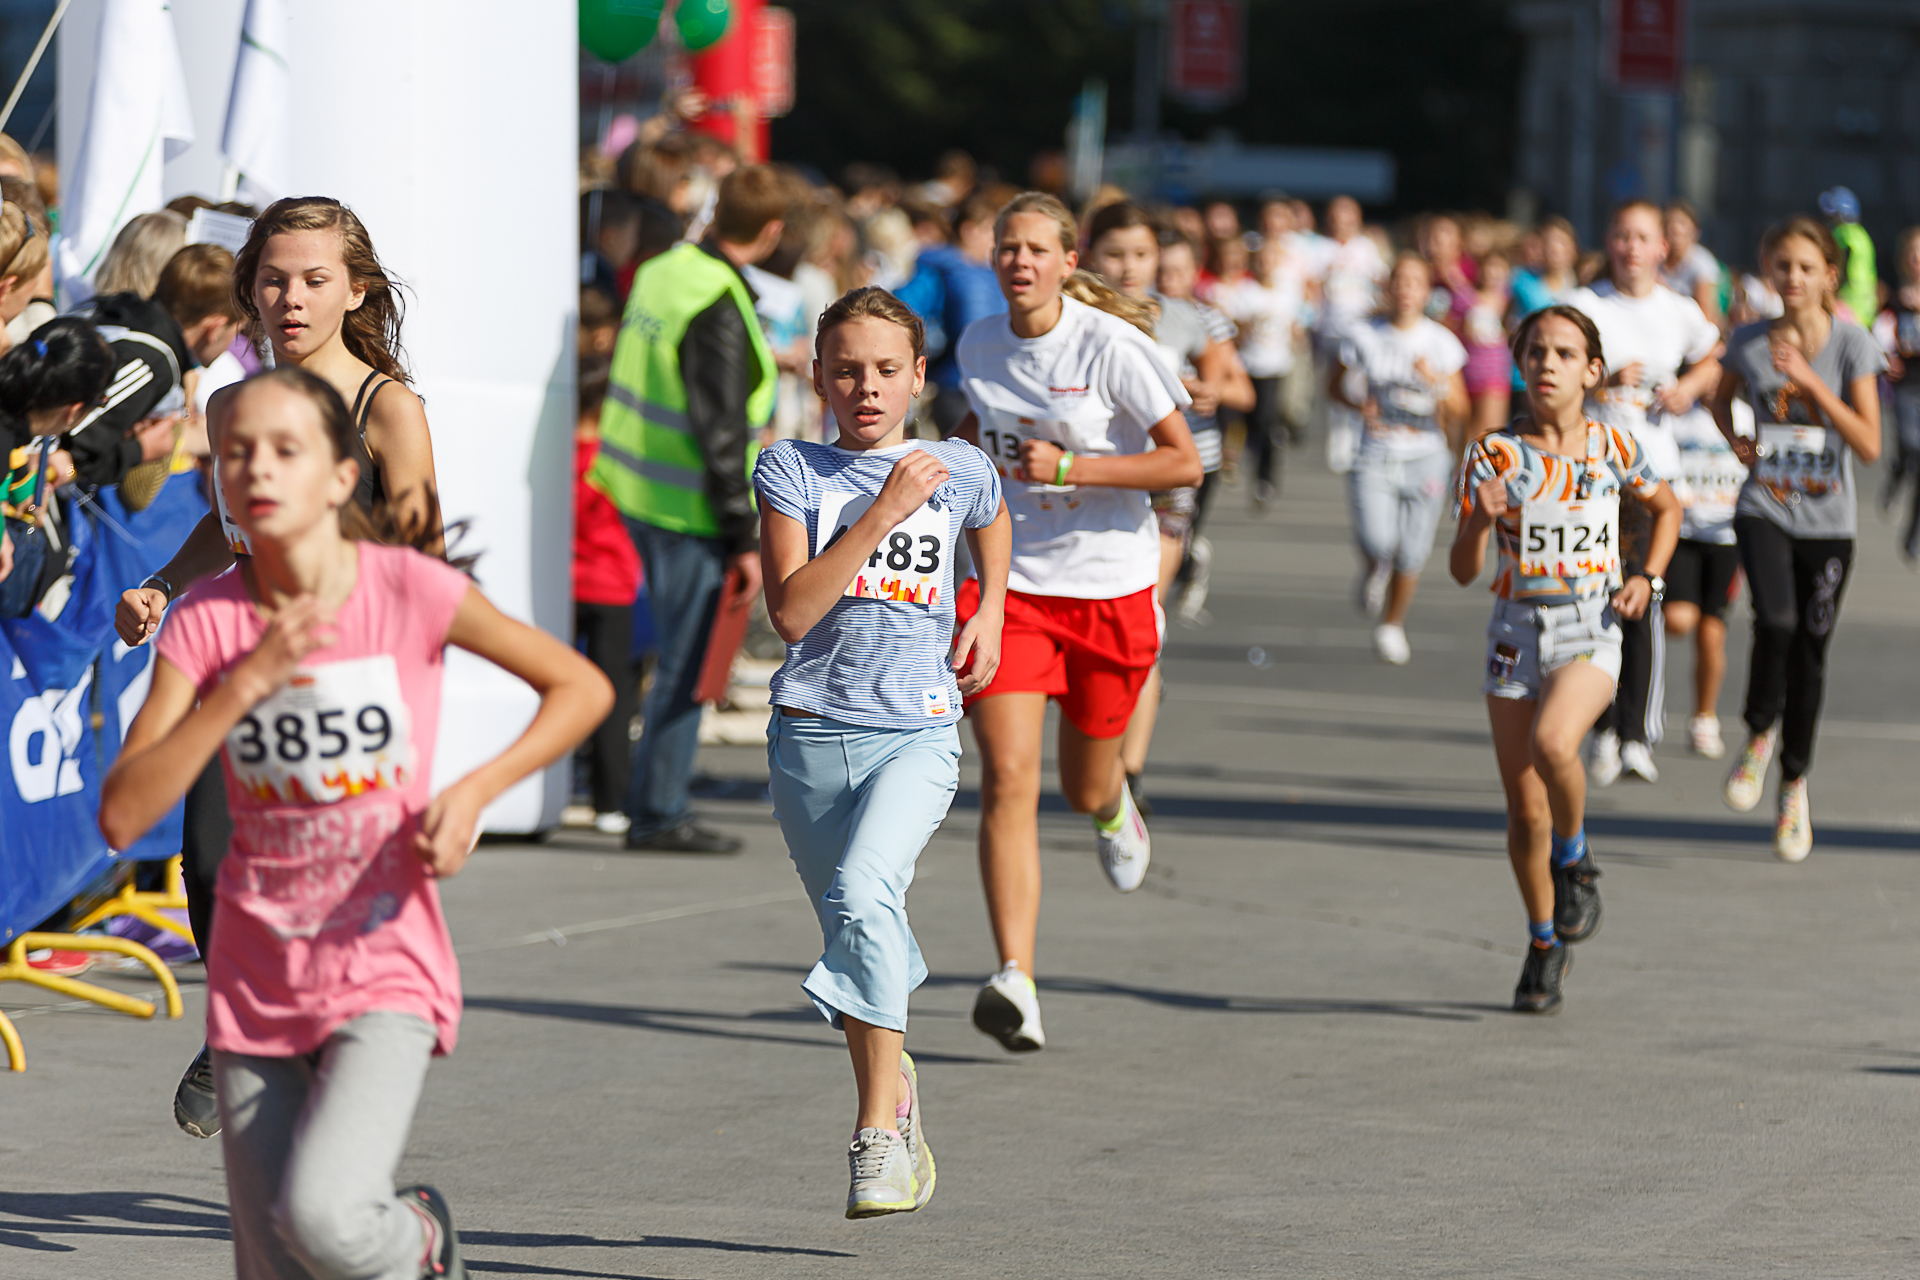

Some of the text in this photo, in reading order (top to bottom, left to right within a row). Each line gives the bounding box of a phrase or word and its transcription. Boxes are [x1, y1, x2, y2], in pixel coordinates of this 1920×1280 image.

[985, 429, 1066, 460] 13
[1527, 523, 1610, 552] 5124
[237, 705, 392, 764] 3859
